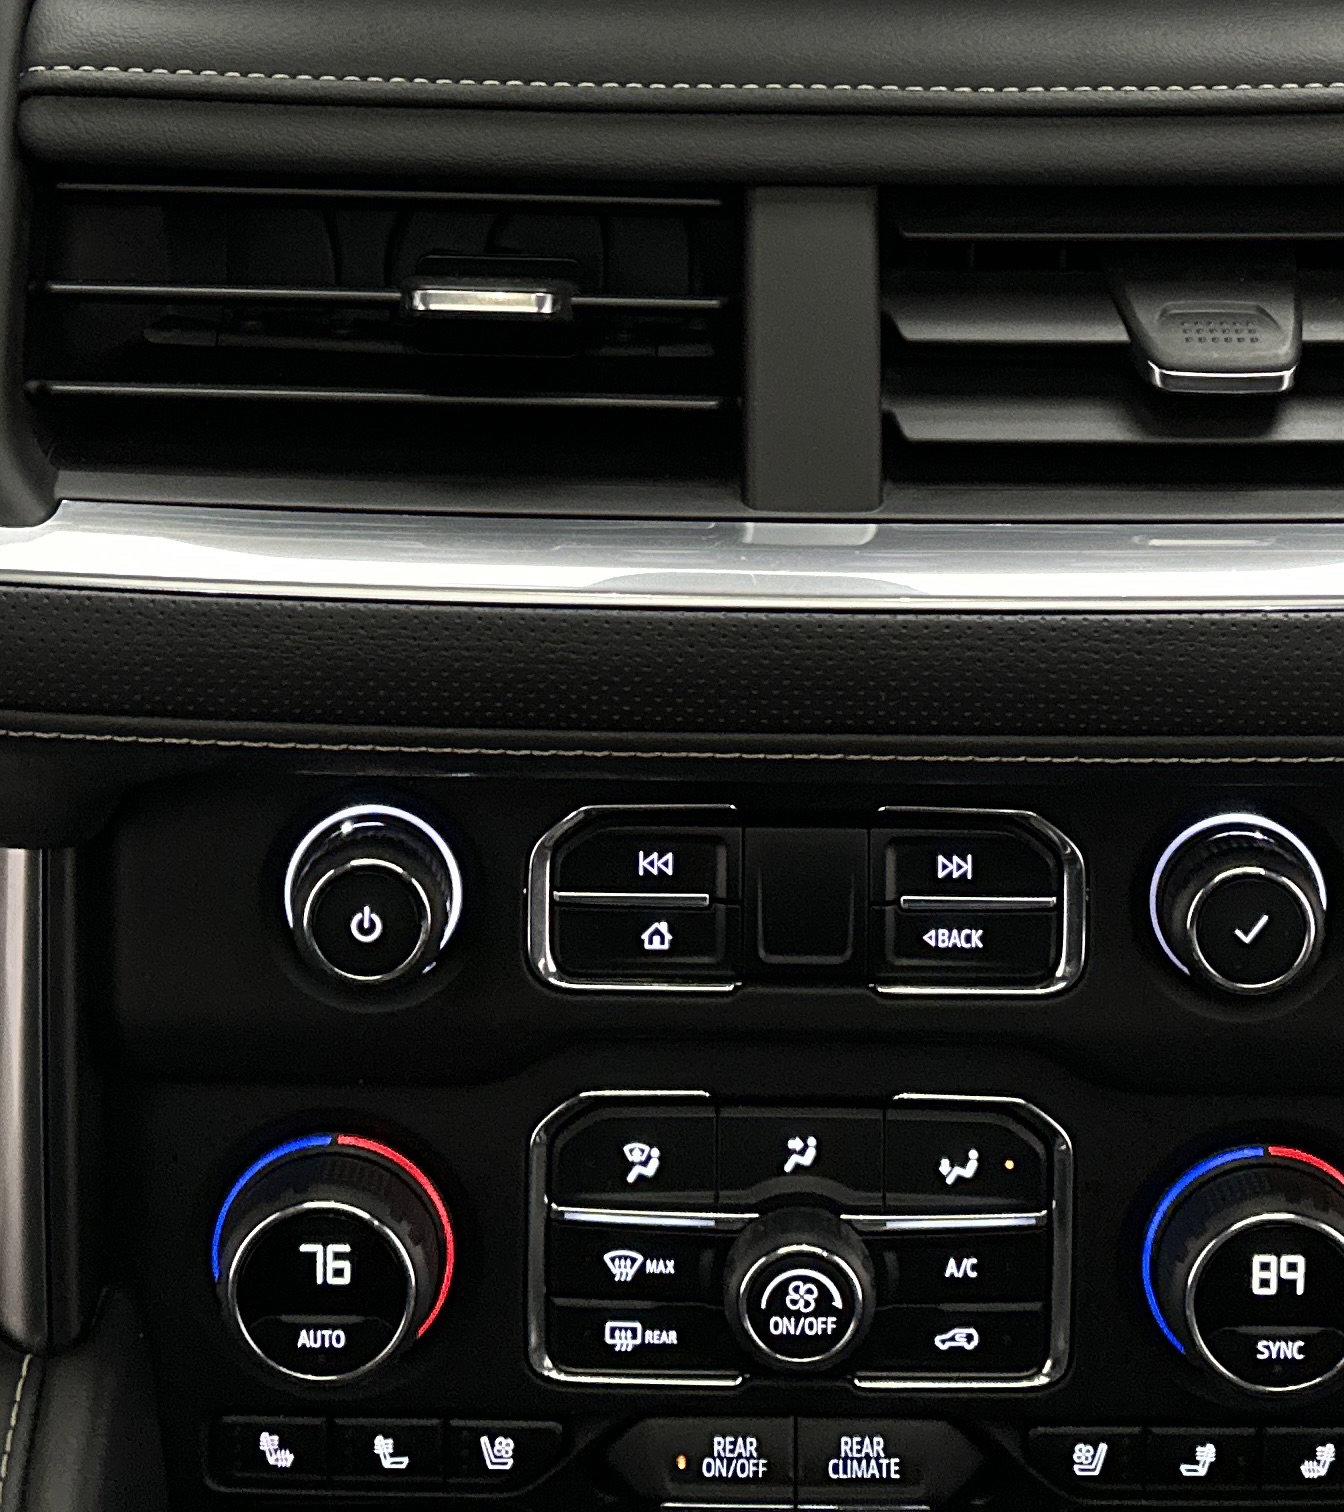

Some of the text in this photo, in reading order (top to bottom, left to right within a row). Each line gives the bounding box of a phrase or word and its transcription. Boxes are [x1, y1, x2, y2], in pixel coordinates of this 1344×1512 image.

[937, 928, 984, 949] BACK
[298, 1243, 352, 1286] 76
[645, 1258, 675, 1275] MAX
[944, 1257, 978, 1279] A/C
[1251, 1253, 1306, 1296] 89
[769, 1315, 838, 1336] ON/OFF
[296, 1328, 346, 1349] AUTO
[644, 1329, 678, 1345] REAR
[1256, 1339, 1305, 1360] SYNC
[713, 1435, 758, 1459] REAR
[840, 1435, 886, 1458] REAR
[701, 1457, 768, 1479] ON/OFF
[827, 1457, 901, 1480] CLIMATE
